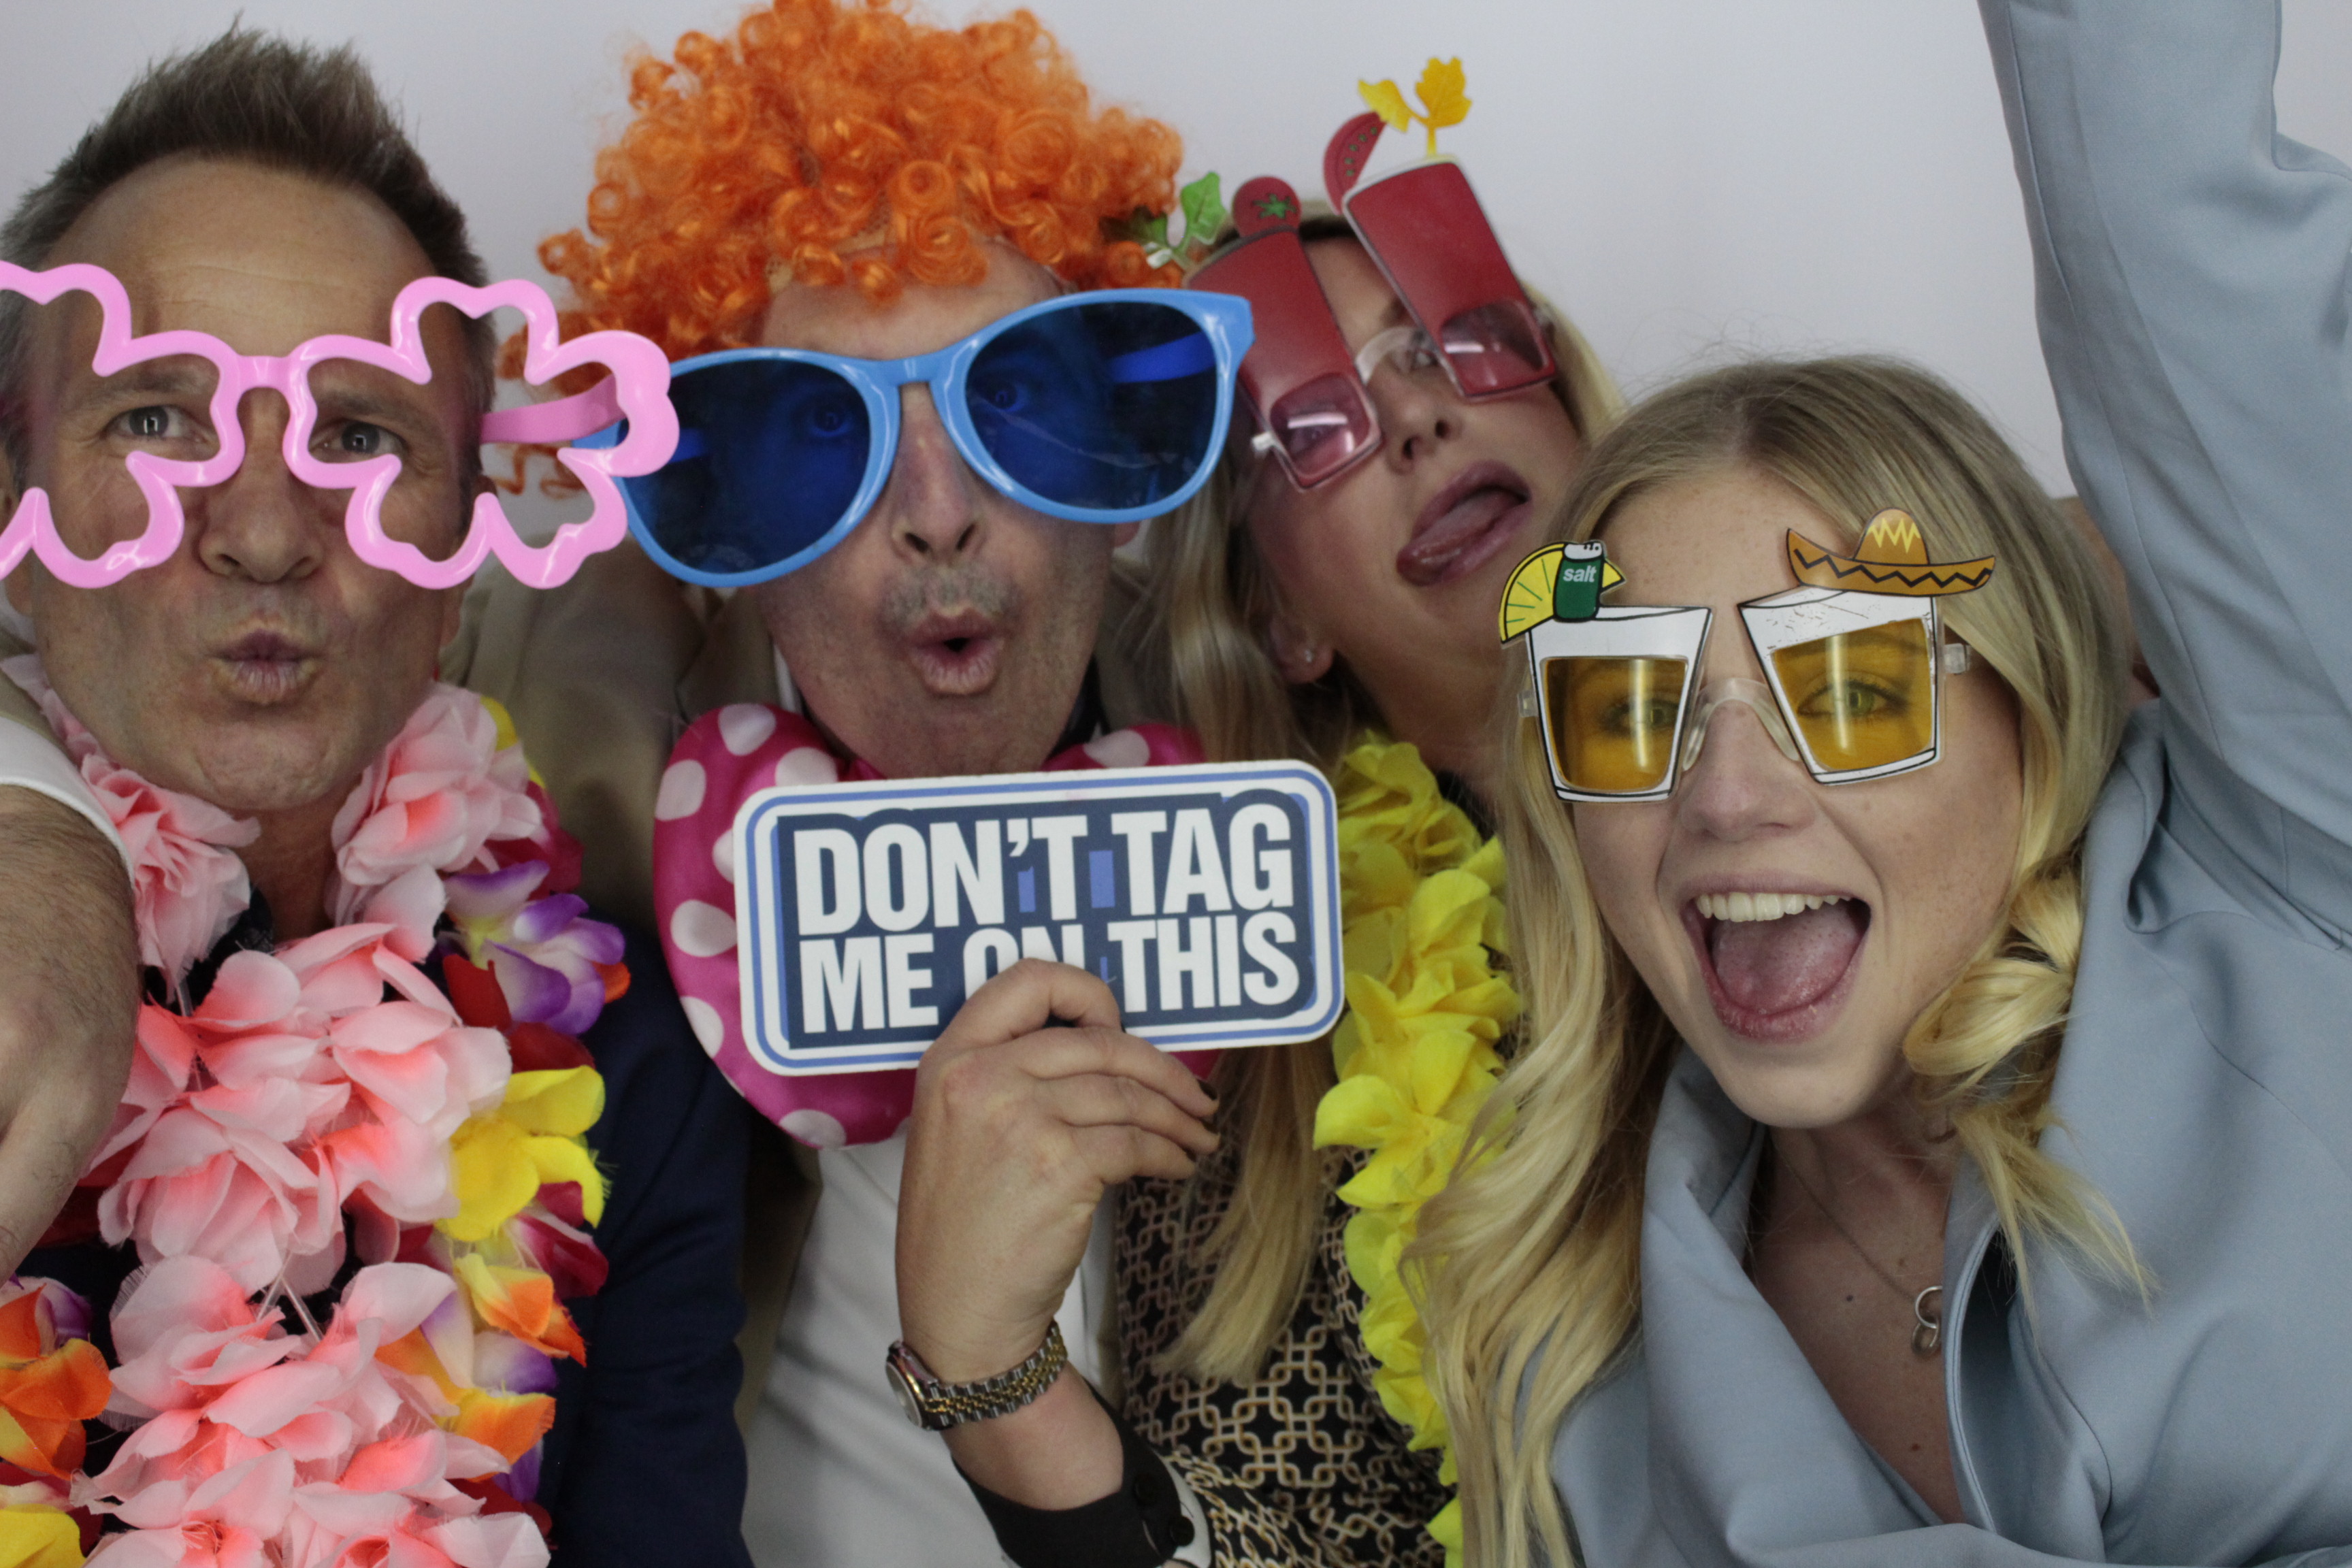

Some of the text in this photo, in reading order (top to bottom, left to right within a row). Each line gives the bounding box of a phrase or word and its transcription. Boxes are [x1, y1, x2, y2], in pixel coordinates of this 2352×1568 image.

[1563, 565, 1597, 583] salt
[793, 803, 1294, 936] DON'T TAG
[799, 933, 939, 1034] ME
[1107, 911, 1300, 1014] THIS
